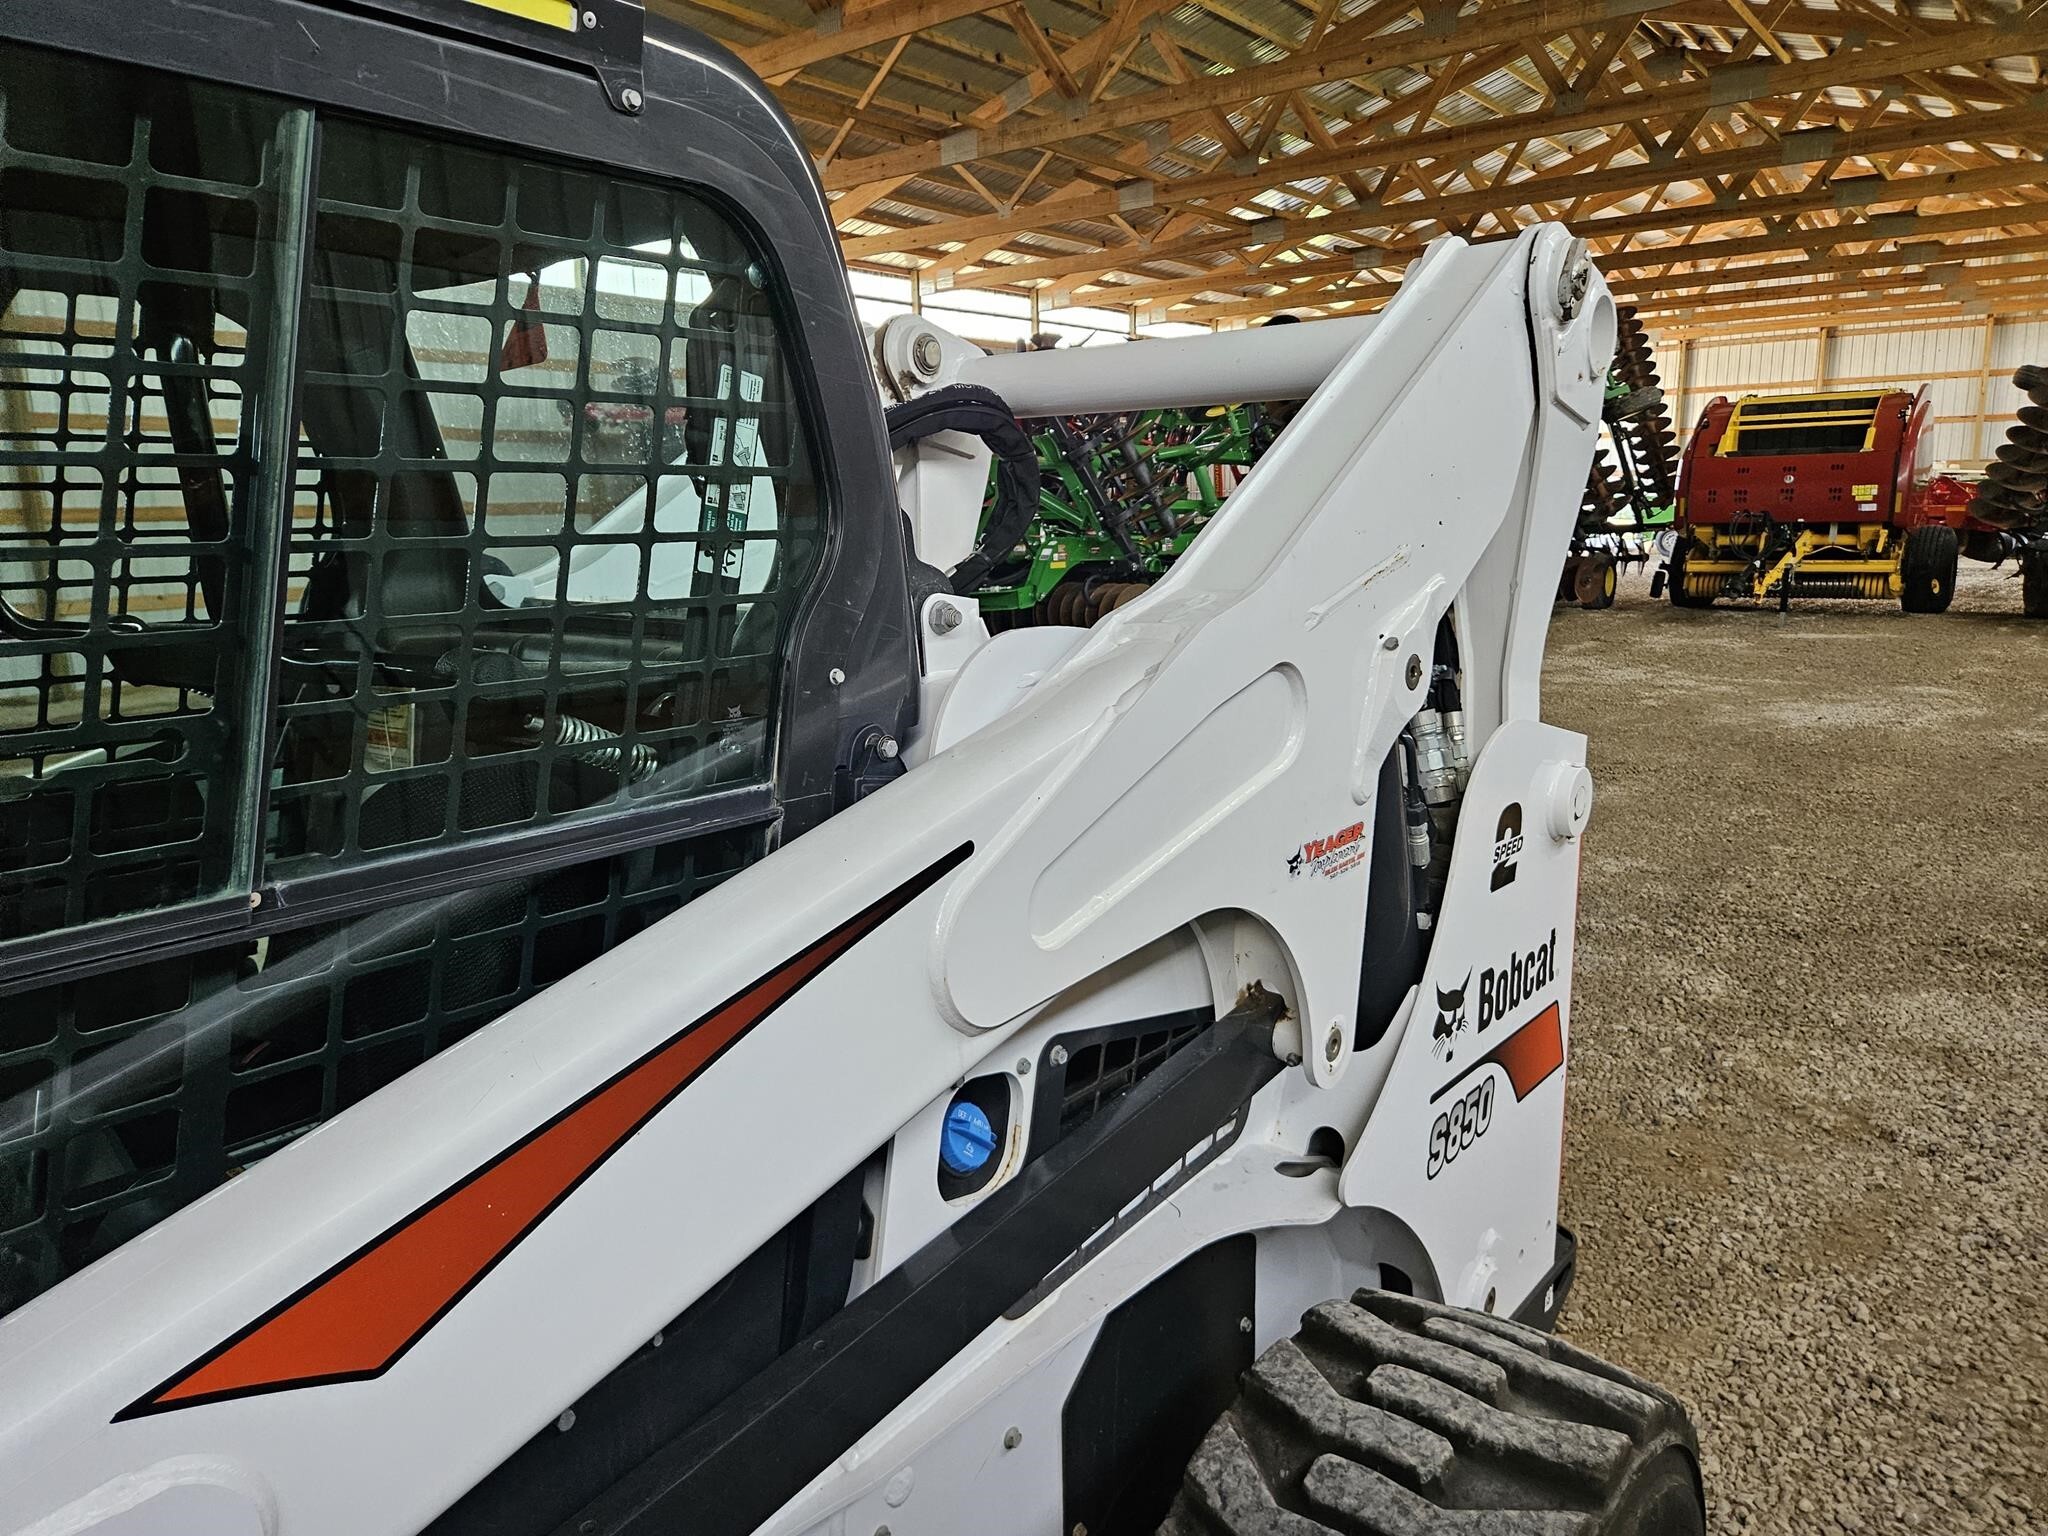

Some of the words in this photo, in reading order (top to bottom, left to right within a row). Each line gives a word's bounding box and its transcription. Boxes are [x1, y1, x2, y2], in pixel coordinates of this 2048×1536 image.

[1304, 821, 1365, 864] YEAGER
[1490, 802, 1522, 893] 2
[1493, 836, 1523, 864] SPEED
[1478, 928, 1556, 1034] Bobcat
[1427, 1074, 1496, 1181] S850
